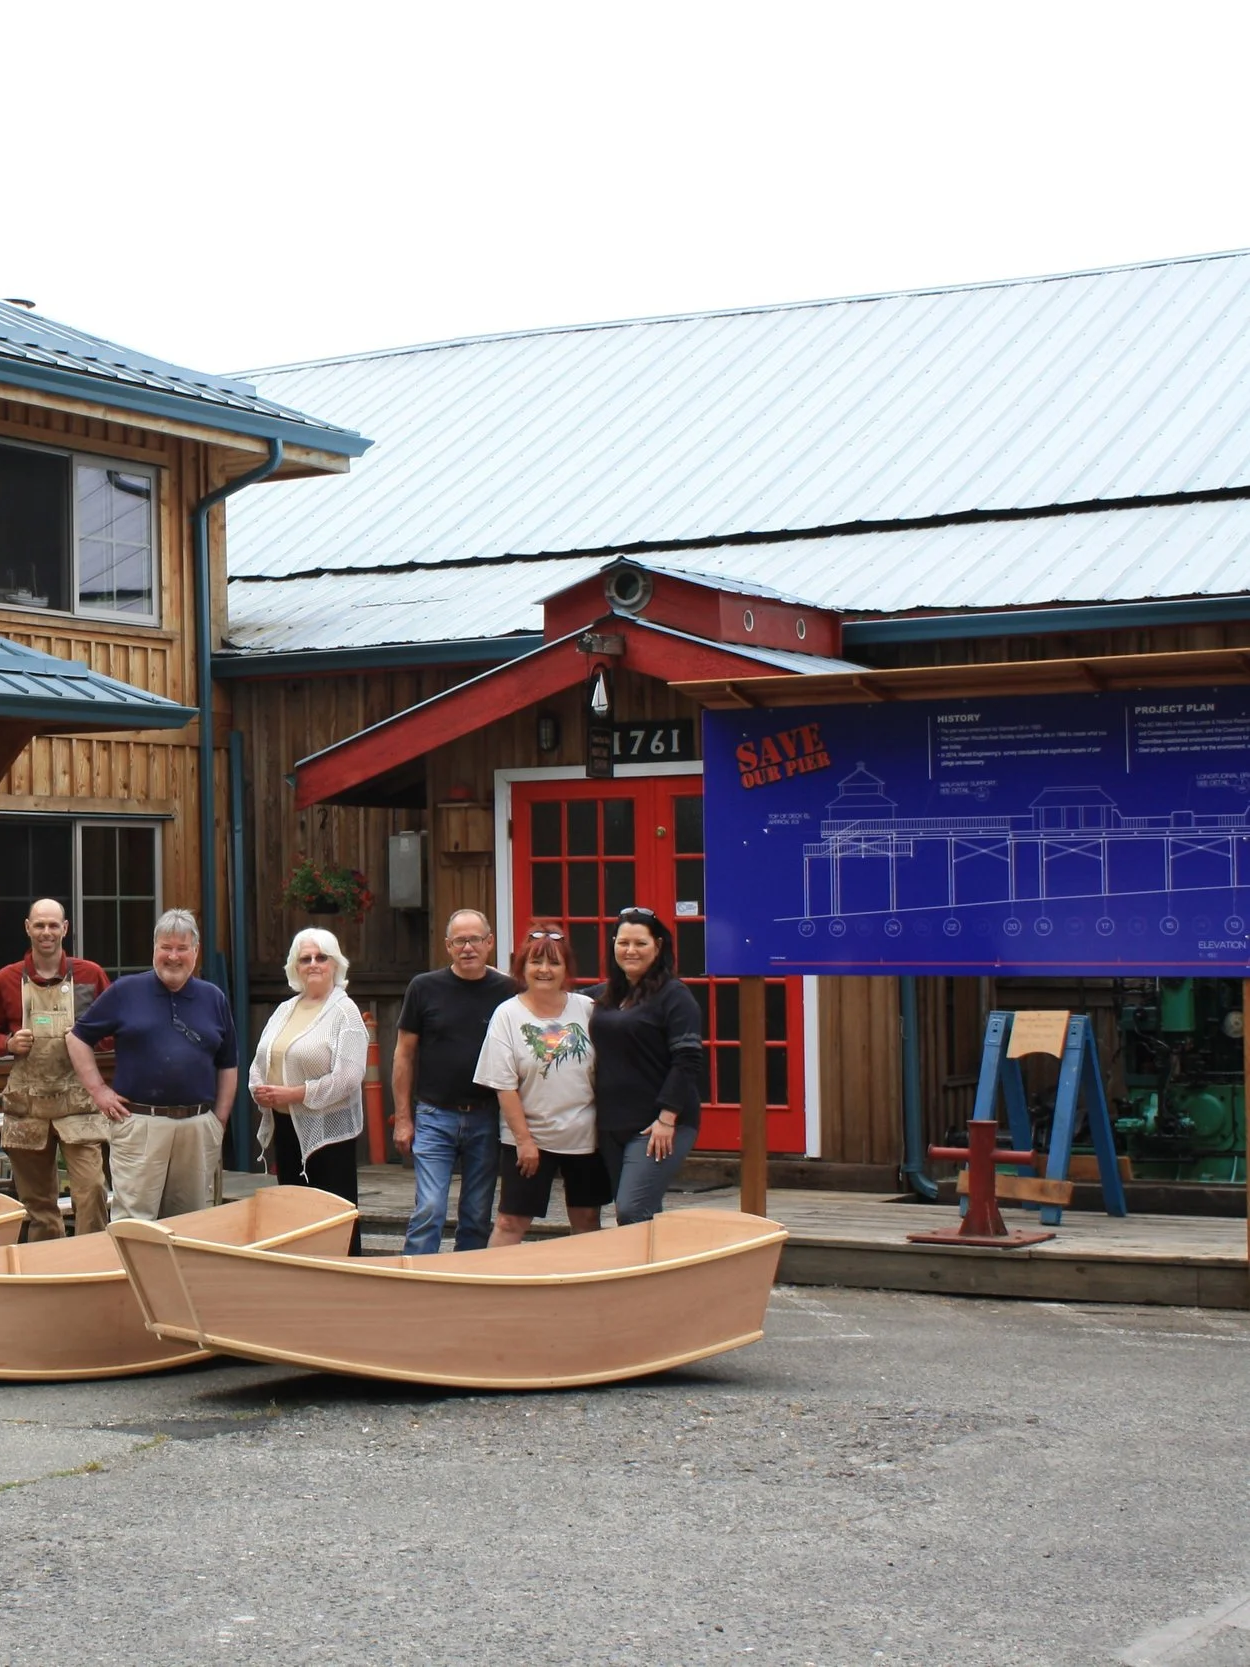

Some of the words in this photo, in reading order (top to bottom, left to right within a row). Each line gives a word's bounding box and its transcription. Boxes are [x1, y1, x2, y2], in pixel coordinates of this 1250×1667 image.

[1135, 705, 1183, 714] PROJECT
[1186, 704, 1215, 712] PLAN
[937, 714, 981, 723] HISTORY
[613, 729, 680, 755] 1761
[736, 722, 825, 774] SAVE
[741, 765, 782, 789] OUR
[786, 751, 831, 777] PIER
[1198, 941, 1247, 950] ELEVATION
